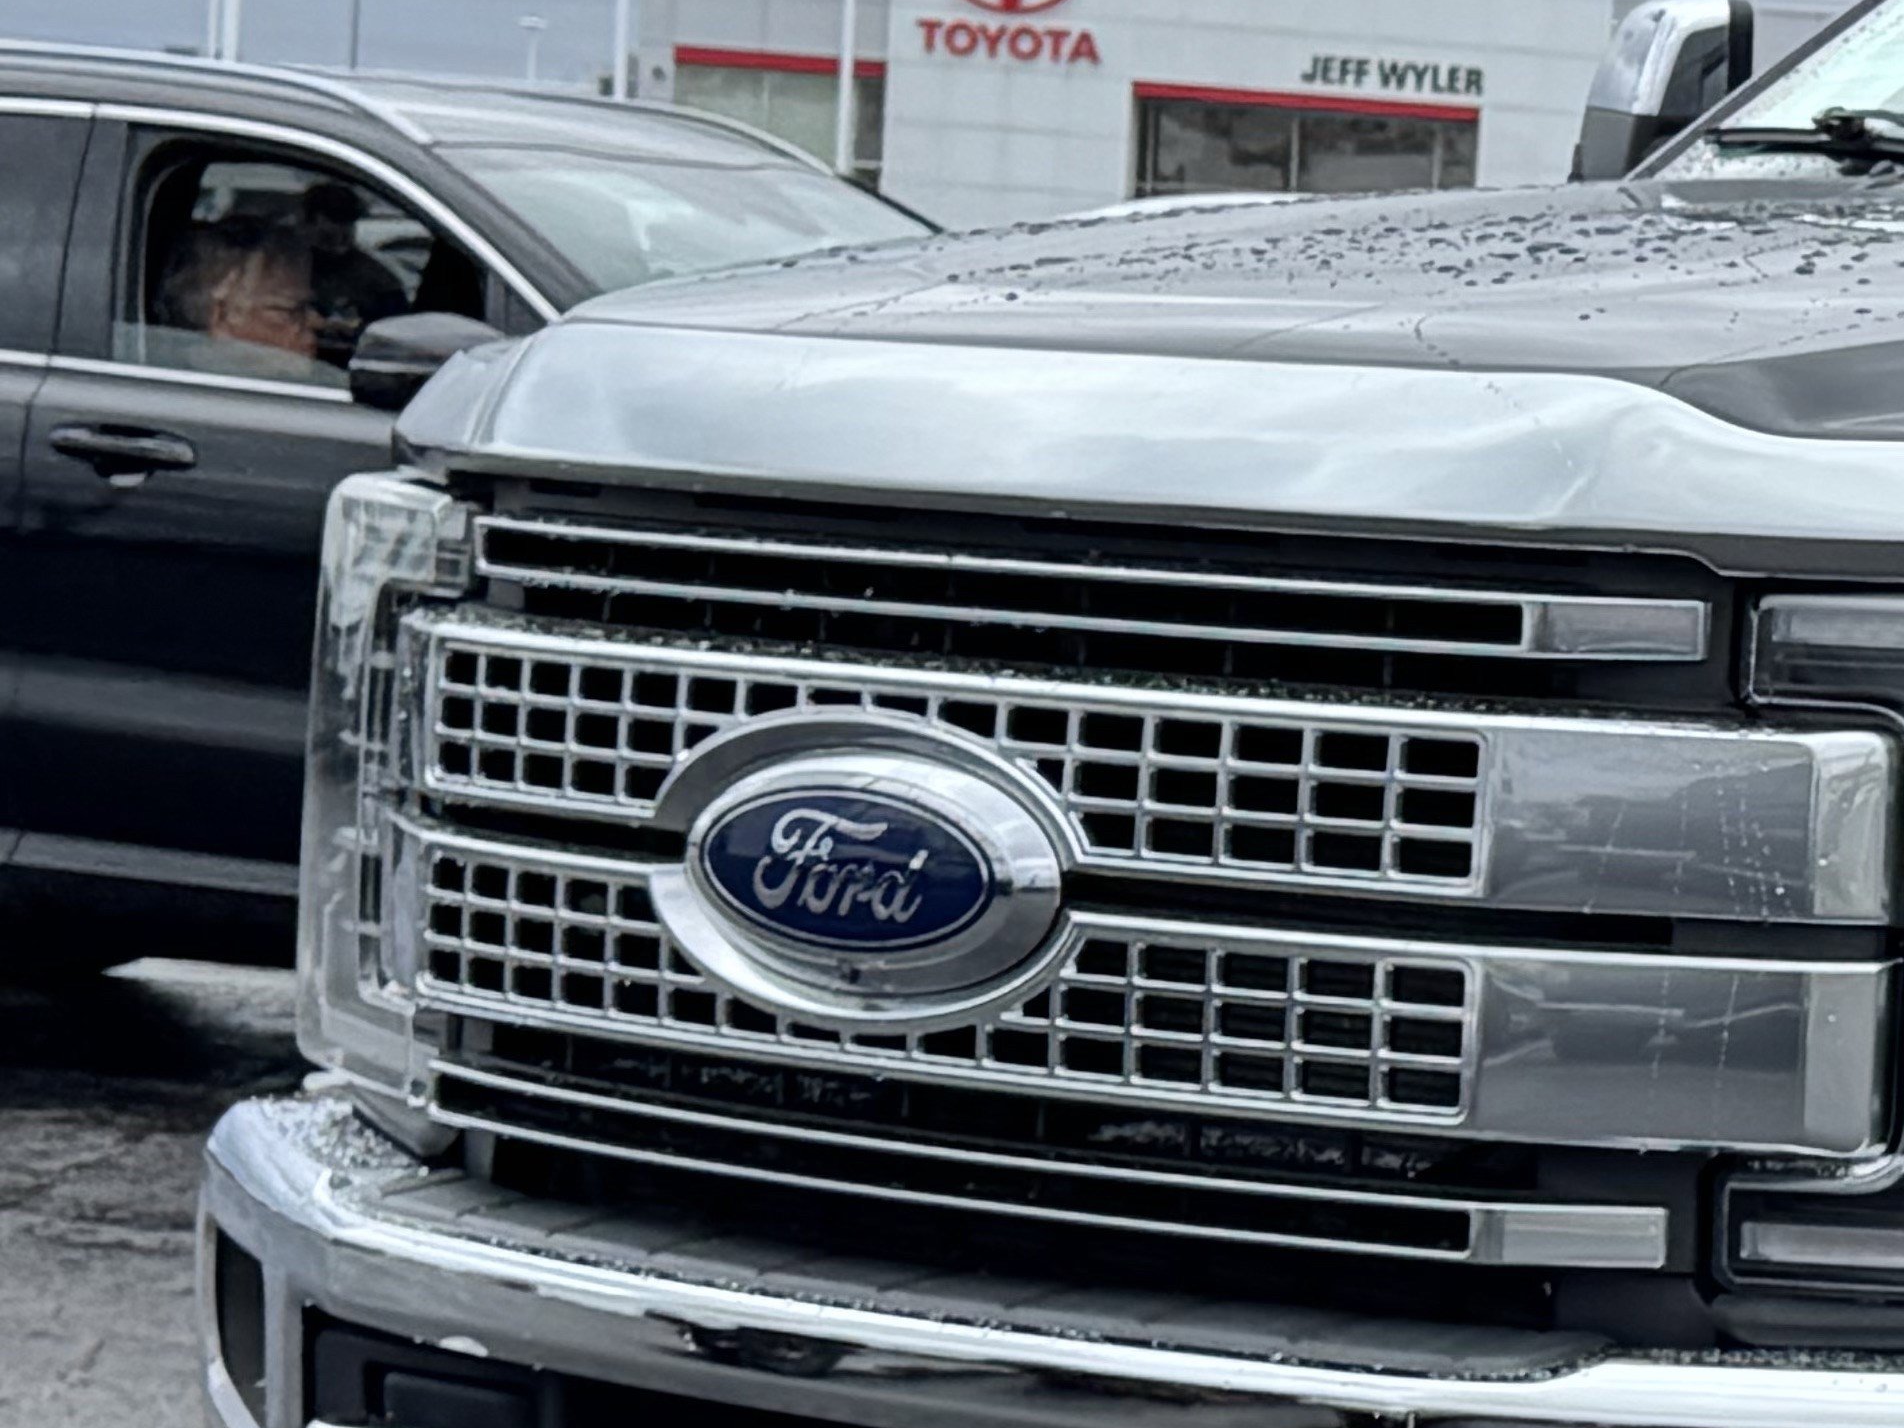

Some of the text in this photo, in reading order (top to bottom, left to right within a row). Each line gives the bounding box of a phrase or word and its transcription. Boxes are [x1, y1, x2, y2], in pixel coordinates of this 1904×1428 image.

[916, 18, 1101, 65] TOYOTA
[1301, 55, 1484, 96] JEFF WYLER
[753, 807, 927, 923] Ford
